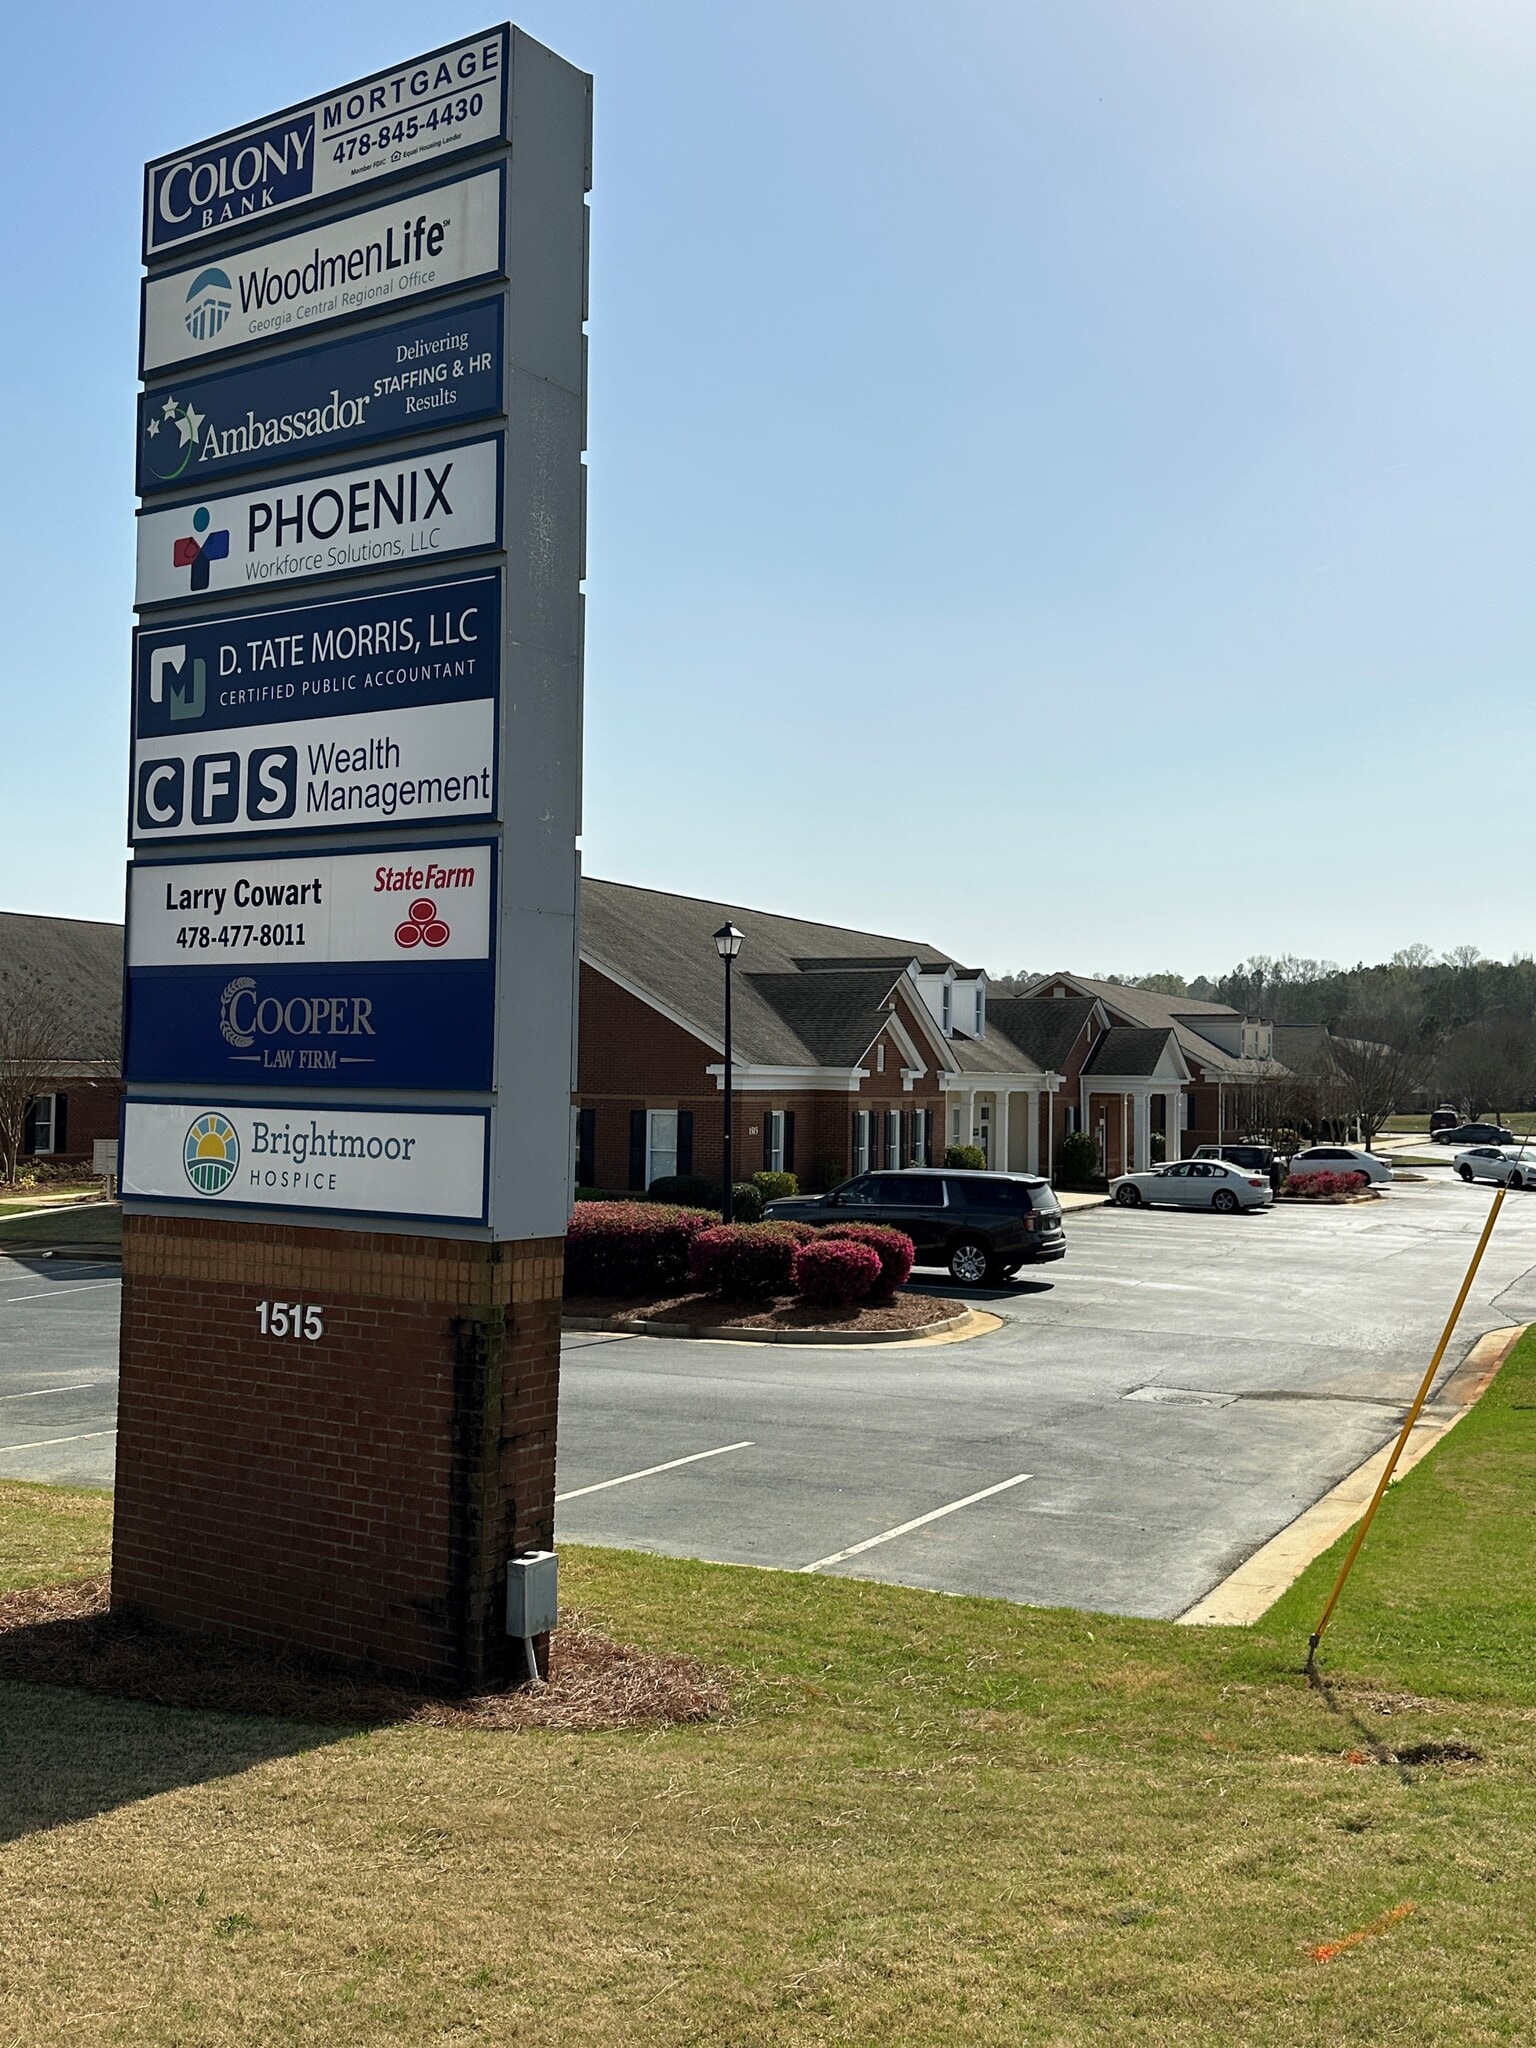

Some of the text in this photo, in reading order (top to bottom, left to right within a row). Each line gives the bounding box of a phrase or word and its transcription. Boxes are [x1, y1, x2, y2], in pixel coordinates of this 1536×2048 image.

[323, 42, 499, 130] MORTGAGE
[333, 93, 483, 163] 478-845-4430
[403, 133, 462, 158] Equal Housing Lender
[159, 125, 313, 223] COLONY
[351, 159, 386, 175] Member FDIC
[201, 187, 274, 229] BANK
[248, 269, 436, 335] Georgia Central Regional Office
[396, 333, 469, 363] Delivering
[374, 352, 492, 397] STAFFING & HR
[405, 388, 457, 414] Results
[199, 389, 370, 462] Ambassador
[249, 463, 453, 552] PHOENIX
[245, 528, 441, 580] Workforce Solutions, LLC
[219, 607, 478, 676] D. TATE MORRIS, LLC
[220, 659, 477, 706] CERTIFIED PUBLIC ACCOUNTANT
[307, 737, 400, 775] Wealth
[306, 766, 490, 815] Management
[166, 878, 322, 915] Larry Cowart
[176, 923, 306, 949] 478-477-8011
[231, 987, 376, 1036] COOPER
[263, 1049, 337, 1070] LAW FIRM
[252, 1120, 416, 1164] Brightmoor
[250, 1169, 337, 1190] HOSPICE
[256, 1301, 324, 1341] 1515
